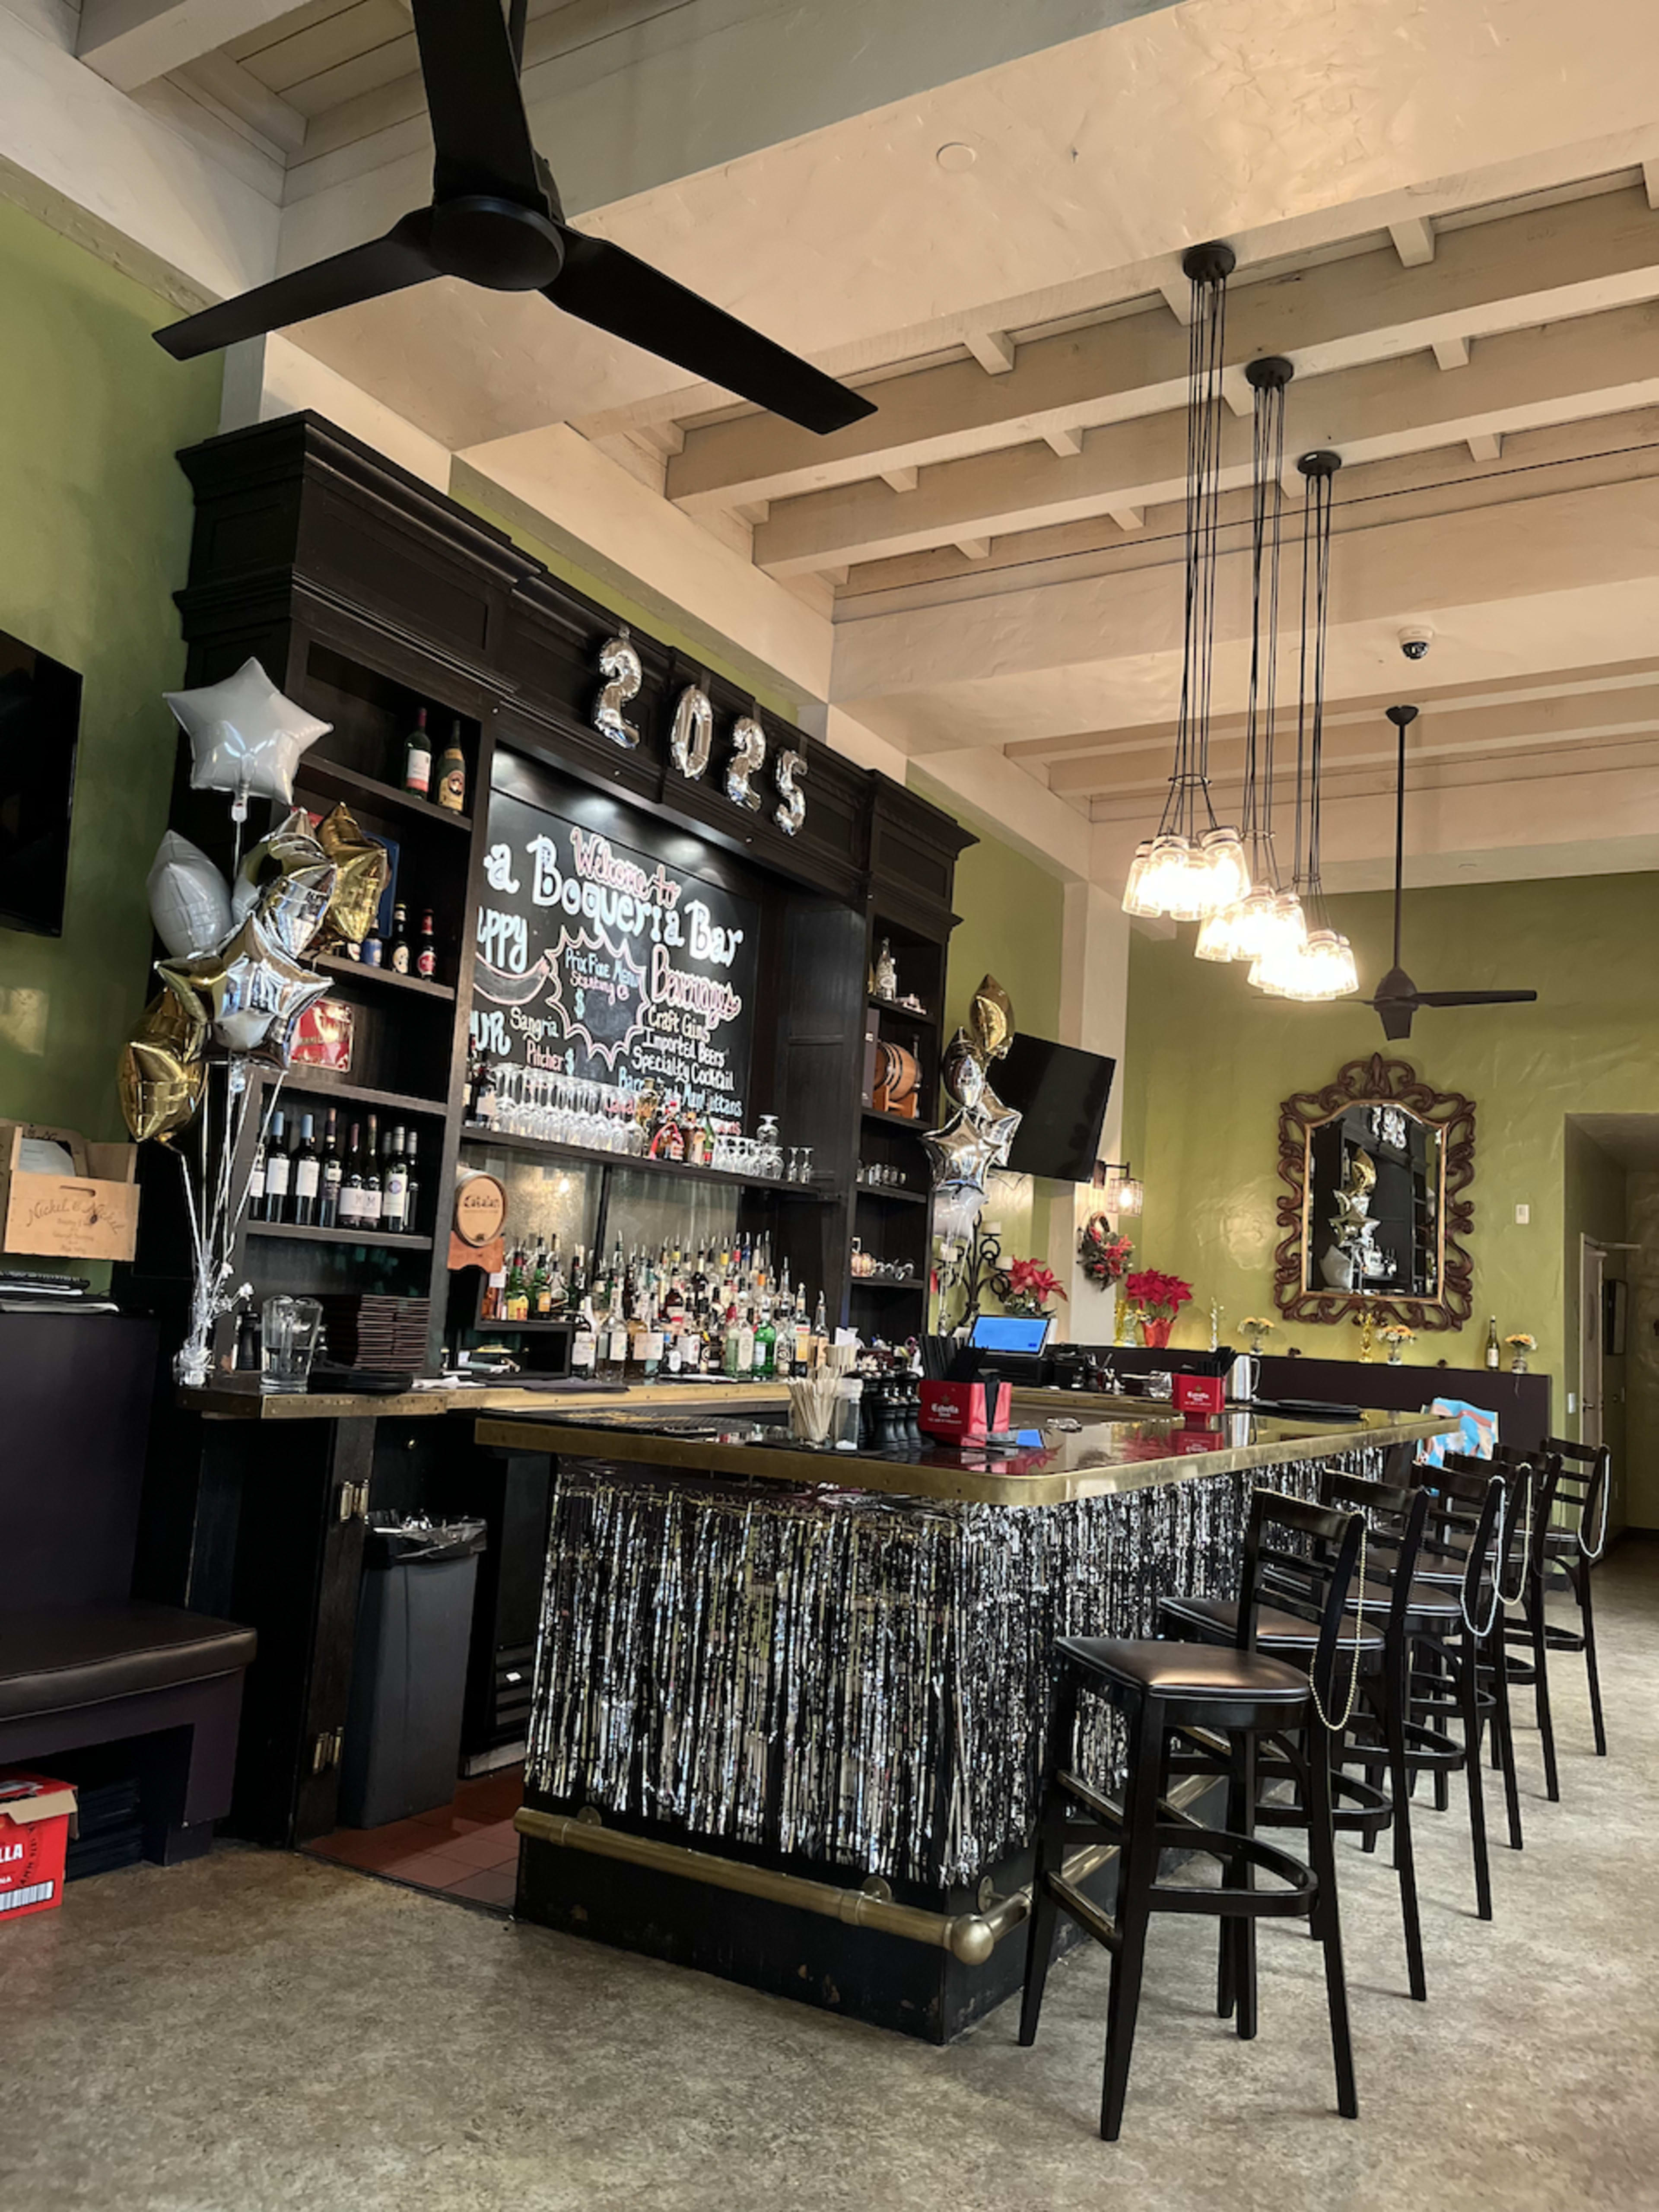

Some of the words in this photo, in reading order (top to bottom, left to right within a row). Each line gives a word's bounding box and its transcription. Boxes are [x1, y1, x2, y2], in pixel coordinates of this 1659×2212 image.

[594, 637, 808, 836] 2025
[570, 826, 650, 901] Welcome
[652, 864, 682, 909] to
[526, 834, 685, 947] Boqueria
[685, 899, 744, 967] Bar
[565, 947, 587, 974] Prix
[570, 970, 615, 1006] Starting
[509, 1006, 559, 1042] Sangria
[648, 1004, 680, 1033] Craft
[527, 1039, 564, 1072] Pitcher
[642, 1026, 697, 1059] Imported
